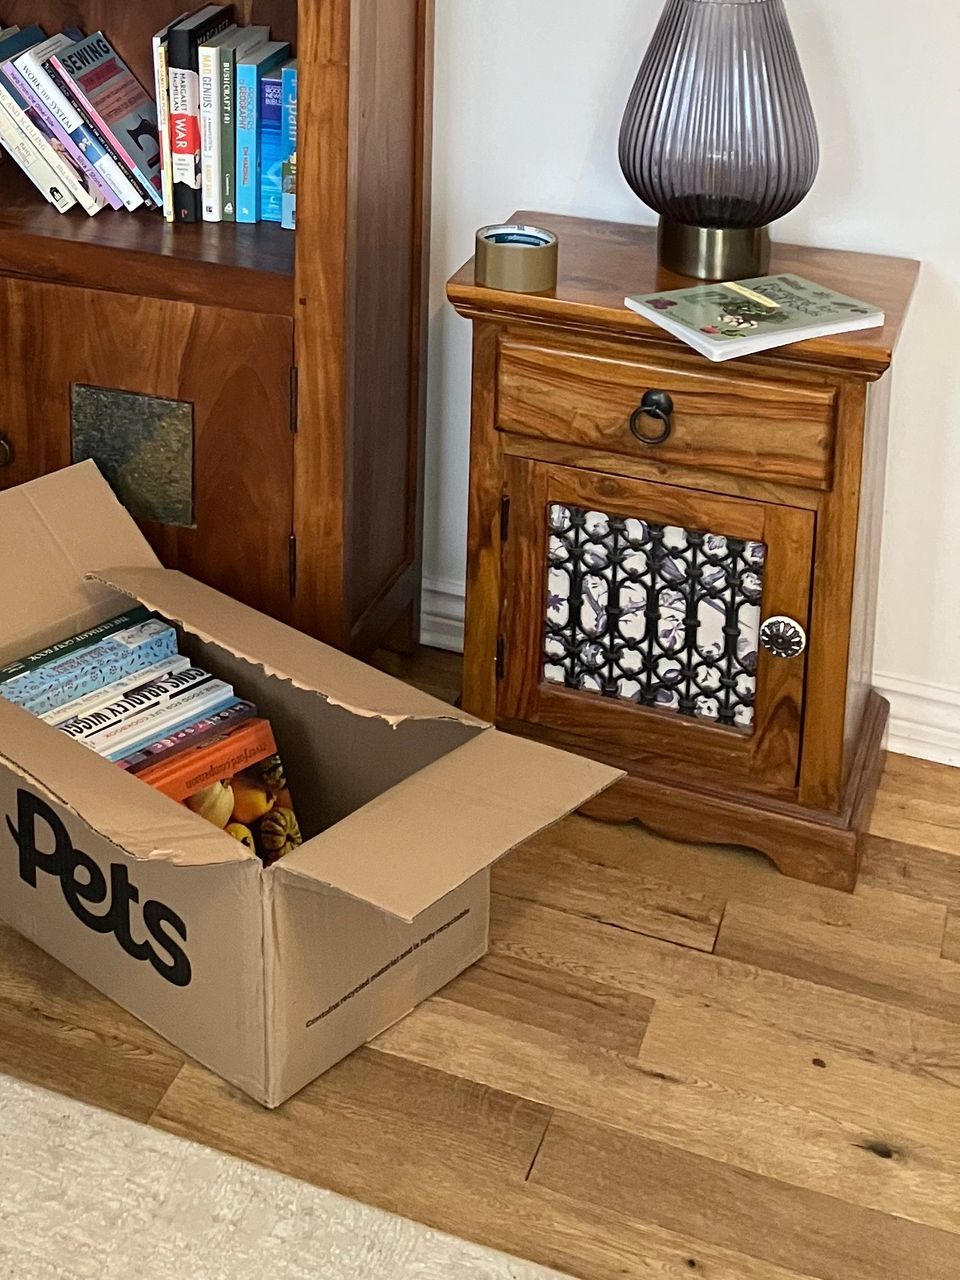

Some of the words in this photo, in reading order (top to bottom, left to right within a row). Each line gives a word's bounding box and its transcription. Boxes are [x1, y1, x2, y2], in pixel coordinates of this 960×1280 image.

[62, 39, 110, 75] SEWING
[202, 55, 211, 75] MAD
[22, 65, 41, 88] WORK
[51, 99, 73, 129] SYSTEM
[179, 73, 187, 111] MARGARET
[203, 76, 212, 108] GENIUS
[239, 86, 248, 129] GEOGRAPHY
[247, 87, 255, 130] PRISONERS
[6, 101, 20, 117] AND
[19, 114, 46, 151] SCULLING
[175, 118, 188, 149] WAR
[76, 155, 88, 169] Silva
[90, 171, 102, 188] Stone
[26, 648, 52, 662] BOOK
[105, 677, 169, 718] BRADLEY
[166, 700, 181, 709] FOR
[182, 689, 203, 702] FOOD
[106, 716, 148, 738] COOKBOOK
[150, 707, 166, 717] LIFE
[5, 787, 193, 988] Pets
[306, 1000, 340, 1028] Contains
[340, 978, 370, 1004] recycled
